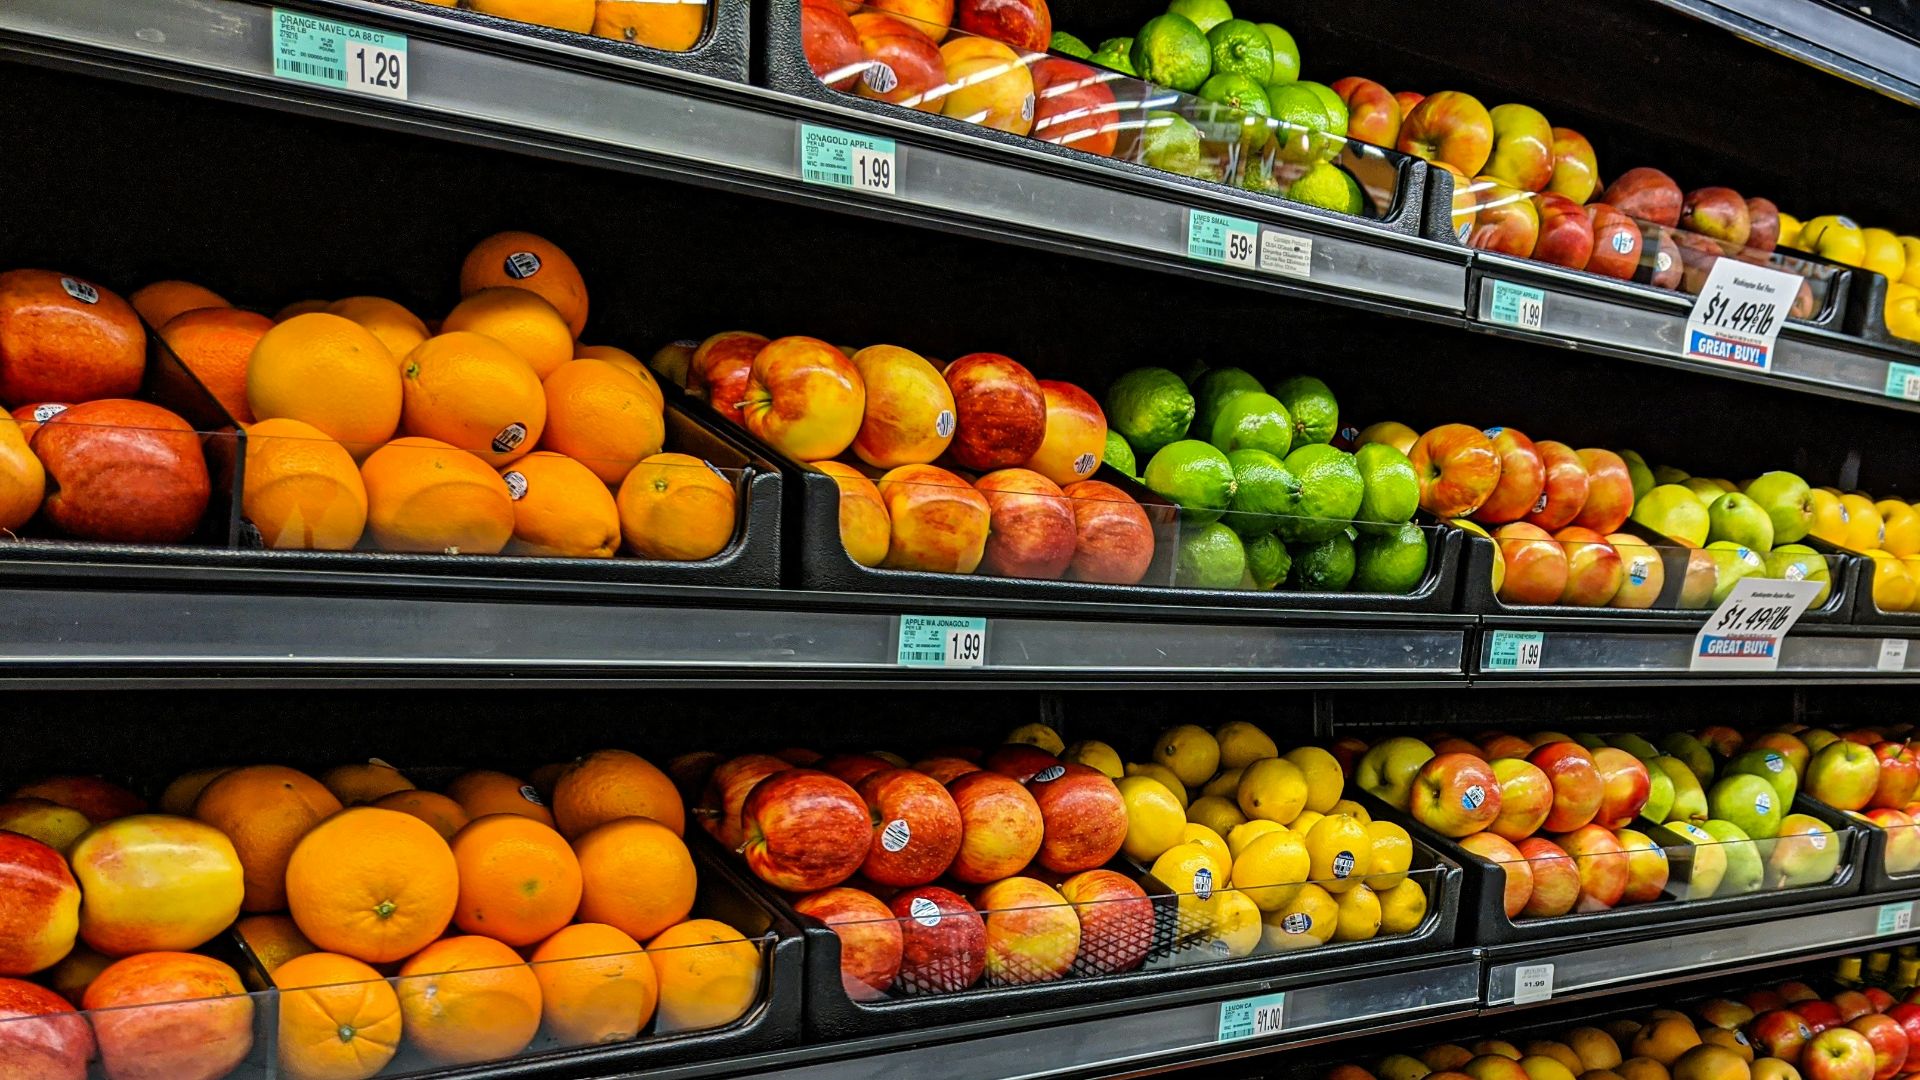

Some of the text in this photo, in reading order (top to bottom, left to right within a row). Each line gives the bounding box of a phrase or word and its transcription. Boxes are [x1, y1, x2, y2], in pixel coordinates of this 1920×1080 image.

[280, 14, 317, 30] ORANGE
[318, 22, 347, 37] NAVEL
[348, 28, 361, 39] CA
[373, 33, 385, 44] CT
[281, 23, 307, 34] PER LB
[280, 47, 296, 57] WIC
[356, 47, 400, 90] 1.29
[806, 132, 874, 150] JONAGOLD APPLE
[859, 155, 890, 188] 1.99
[1193, 213, 1230, 227] LIMES SMALL
[1522, 302, 1540, 326] 1.99
[1703, 291, 1758, 331] $1.49
[1697, 337, 1733, 358] GREAT
[1733, 344, 1761, 363] BUY!
[905, 618, 925, 626] APPLE
[936, 620, 970, 628] JONAGOLD
[1717, 604, 1775, 631] $1.49
[952, 632, 981, 660] 1.99
[1521, 643, 1539, 665] 1.99
[1707, 639, 1769, 655] GREAT BUY!
[1225, 1004, 1243, 1012] LEMON
